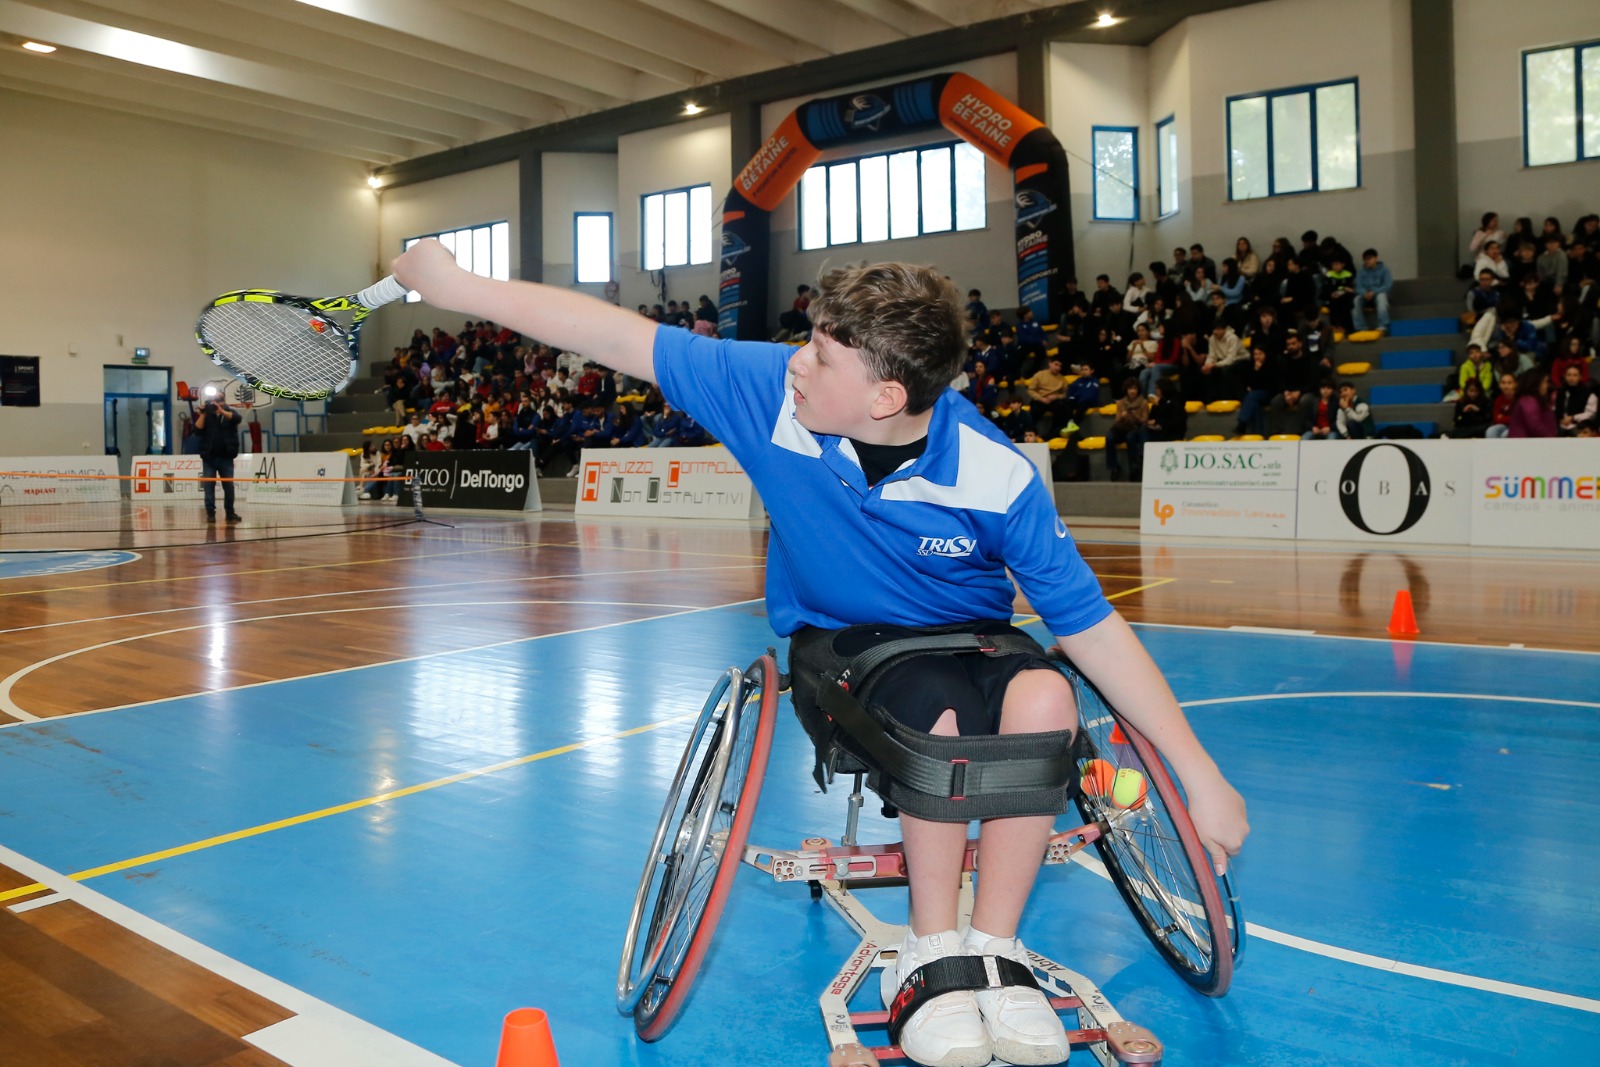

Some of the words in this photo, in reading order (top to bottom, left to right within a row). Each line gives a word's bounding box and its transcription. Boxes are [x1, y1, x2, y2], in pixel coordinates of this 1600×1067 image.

[952, 102, 1012, 148] BETAINE
[961, 93, 1013, 131] HYDRO
[742, 135, 790, 191] BETAINE
[460, 469, 524, 493] DelTongo
[581, 461, 654, 502] ABRUZZO
[667, 461, 744, 488] CONTROLL
[646, 477, 744, 504] DISTRUTTIVI
